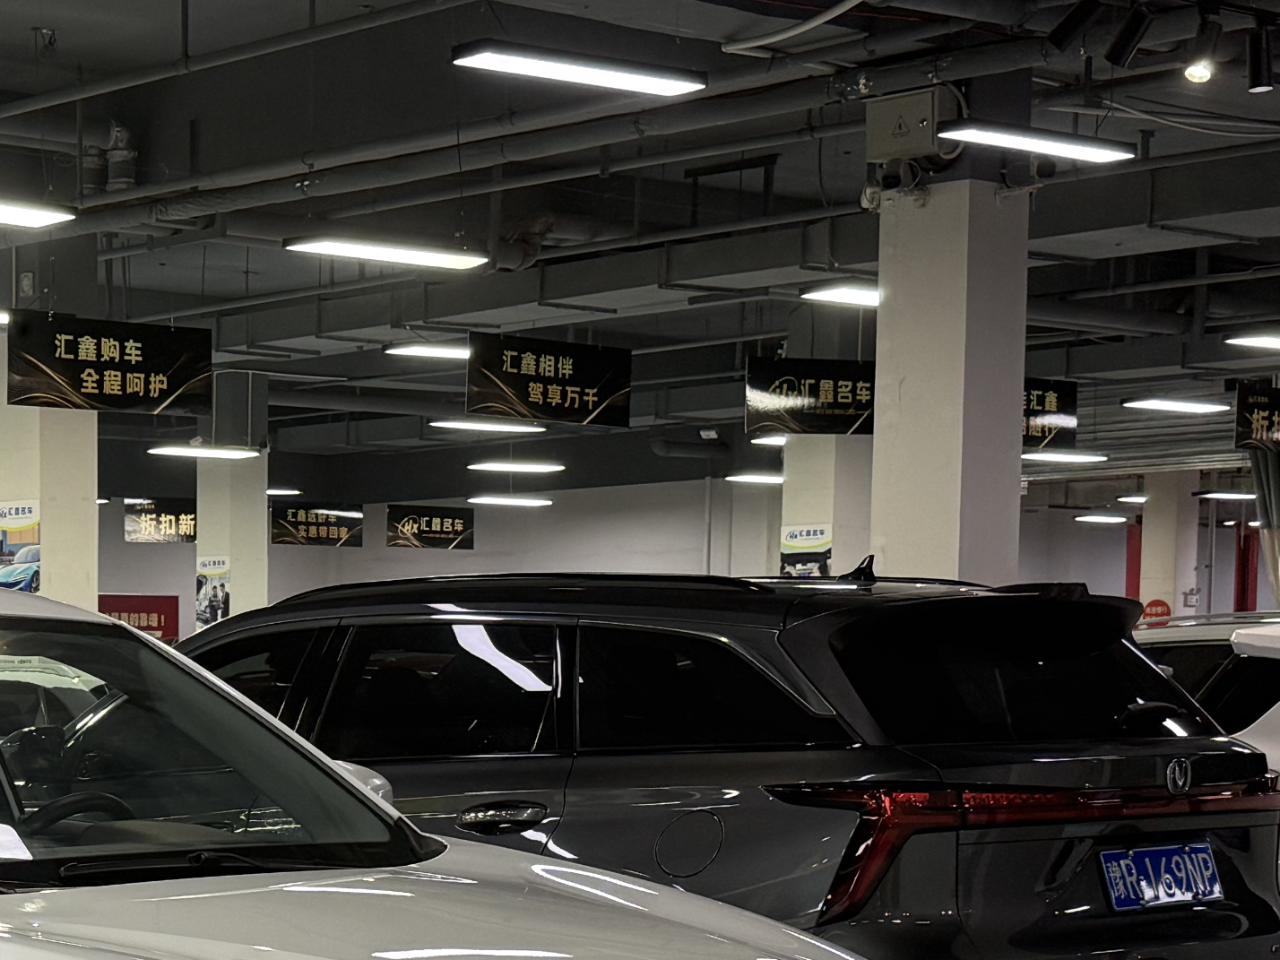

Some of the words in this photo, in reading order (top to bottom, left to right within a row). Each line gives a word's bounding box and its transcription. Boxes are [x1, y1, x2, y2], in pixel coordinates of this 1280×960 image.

[54, 333, 143, 365] 汇鑫购车
[502, 350, 574, 380] 汇鑫相伴
[80, 368, 168, 398] 全程呵护
[528, 382, 599, 410] 驾享万千
[801, 379, 871, 403] 汇鑫名车
[1024, 390, 1057, 411] 汇鑫
[140, 513, 195, 536] 折扣新
